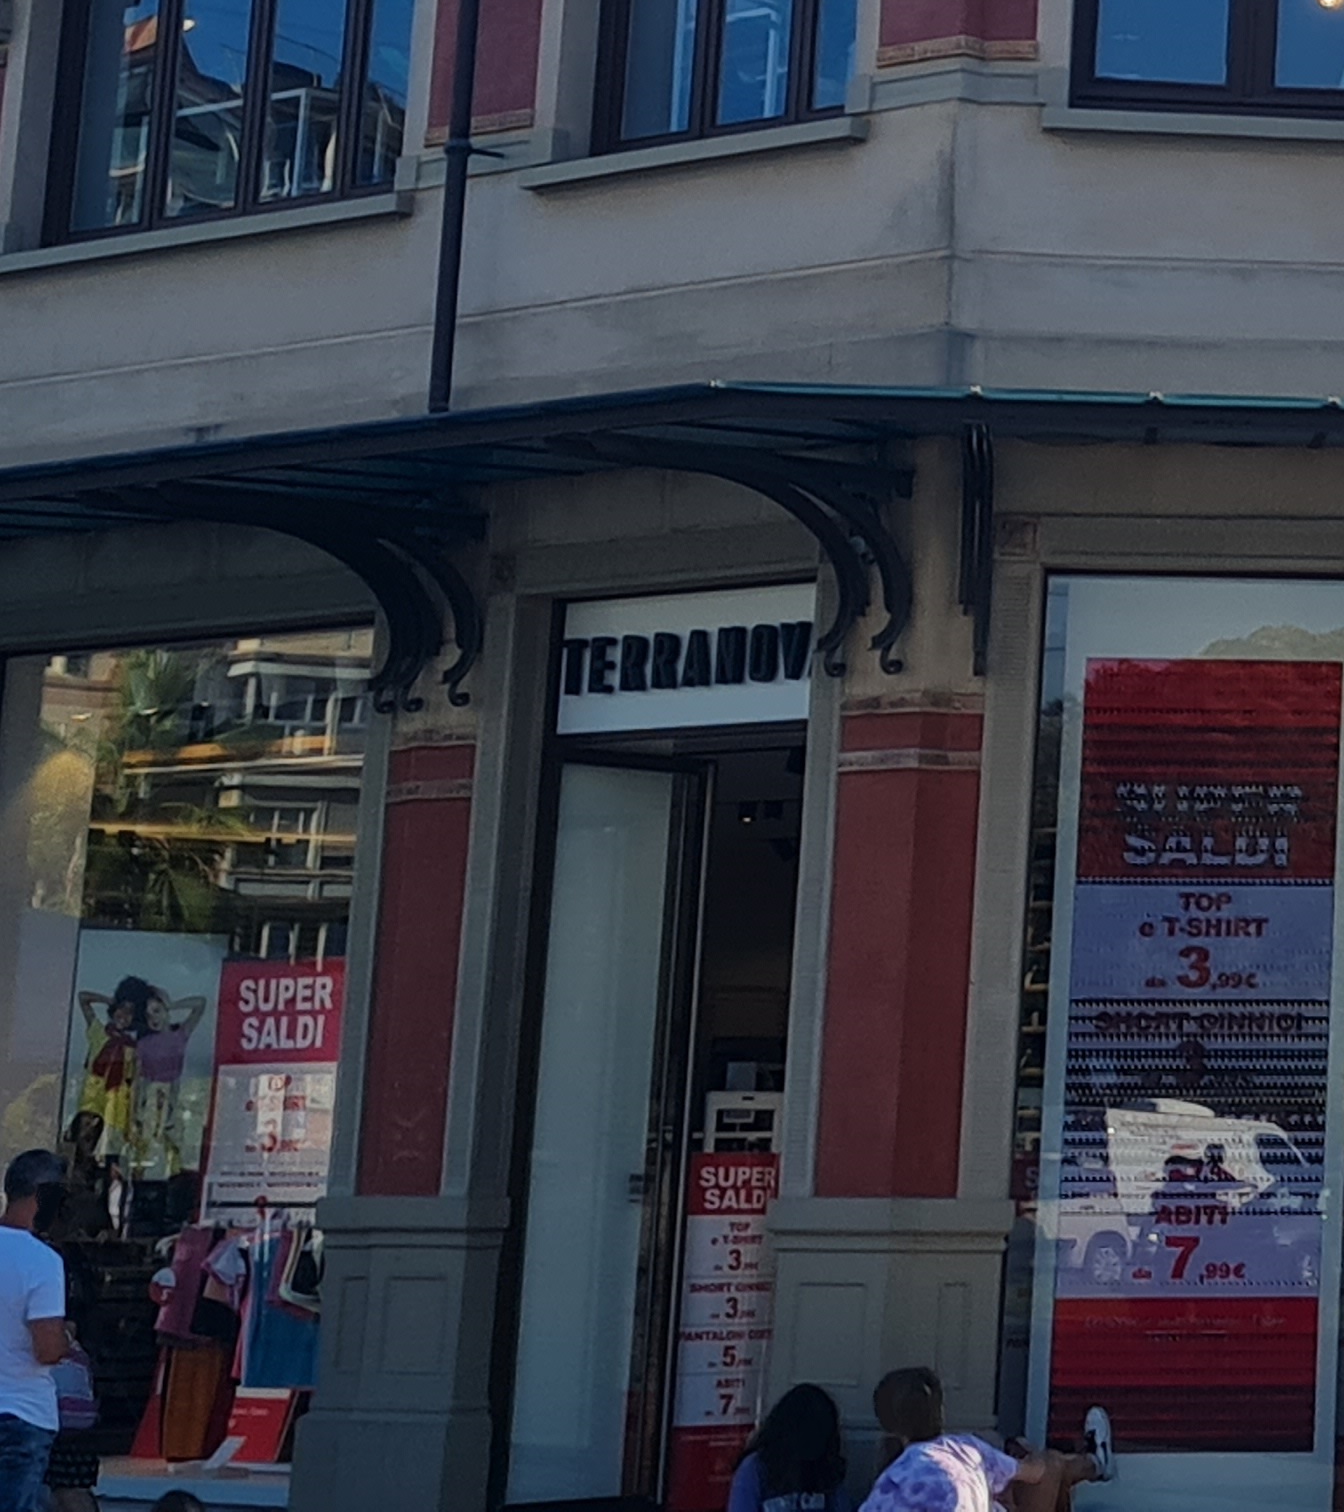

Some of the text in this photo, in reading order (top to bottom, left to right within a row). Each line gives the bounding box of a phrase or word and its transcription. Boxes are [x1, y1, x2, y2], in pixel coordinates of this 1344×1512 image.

[562, 621, 812, 696] TERRANOV
[1179, 892, 1232, 912] TOP
[1162, 917, 1269, 937] T-SHIRT
[239, 976, 333, 1014] SUPER
[241, 1015, 325, 1051] SALDI
[699, 1166, 776, 1188] SUPER
[703, 1188, 769, 1210] SALD
